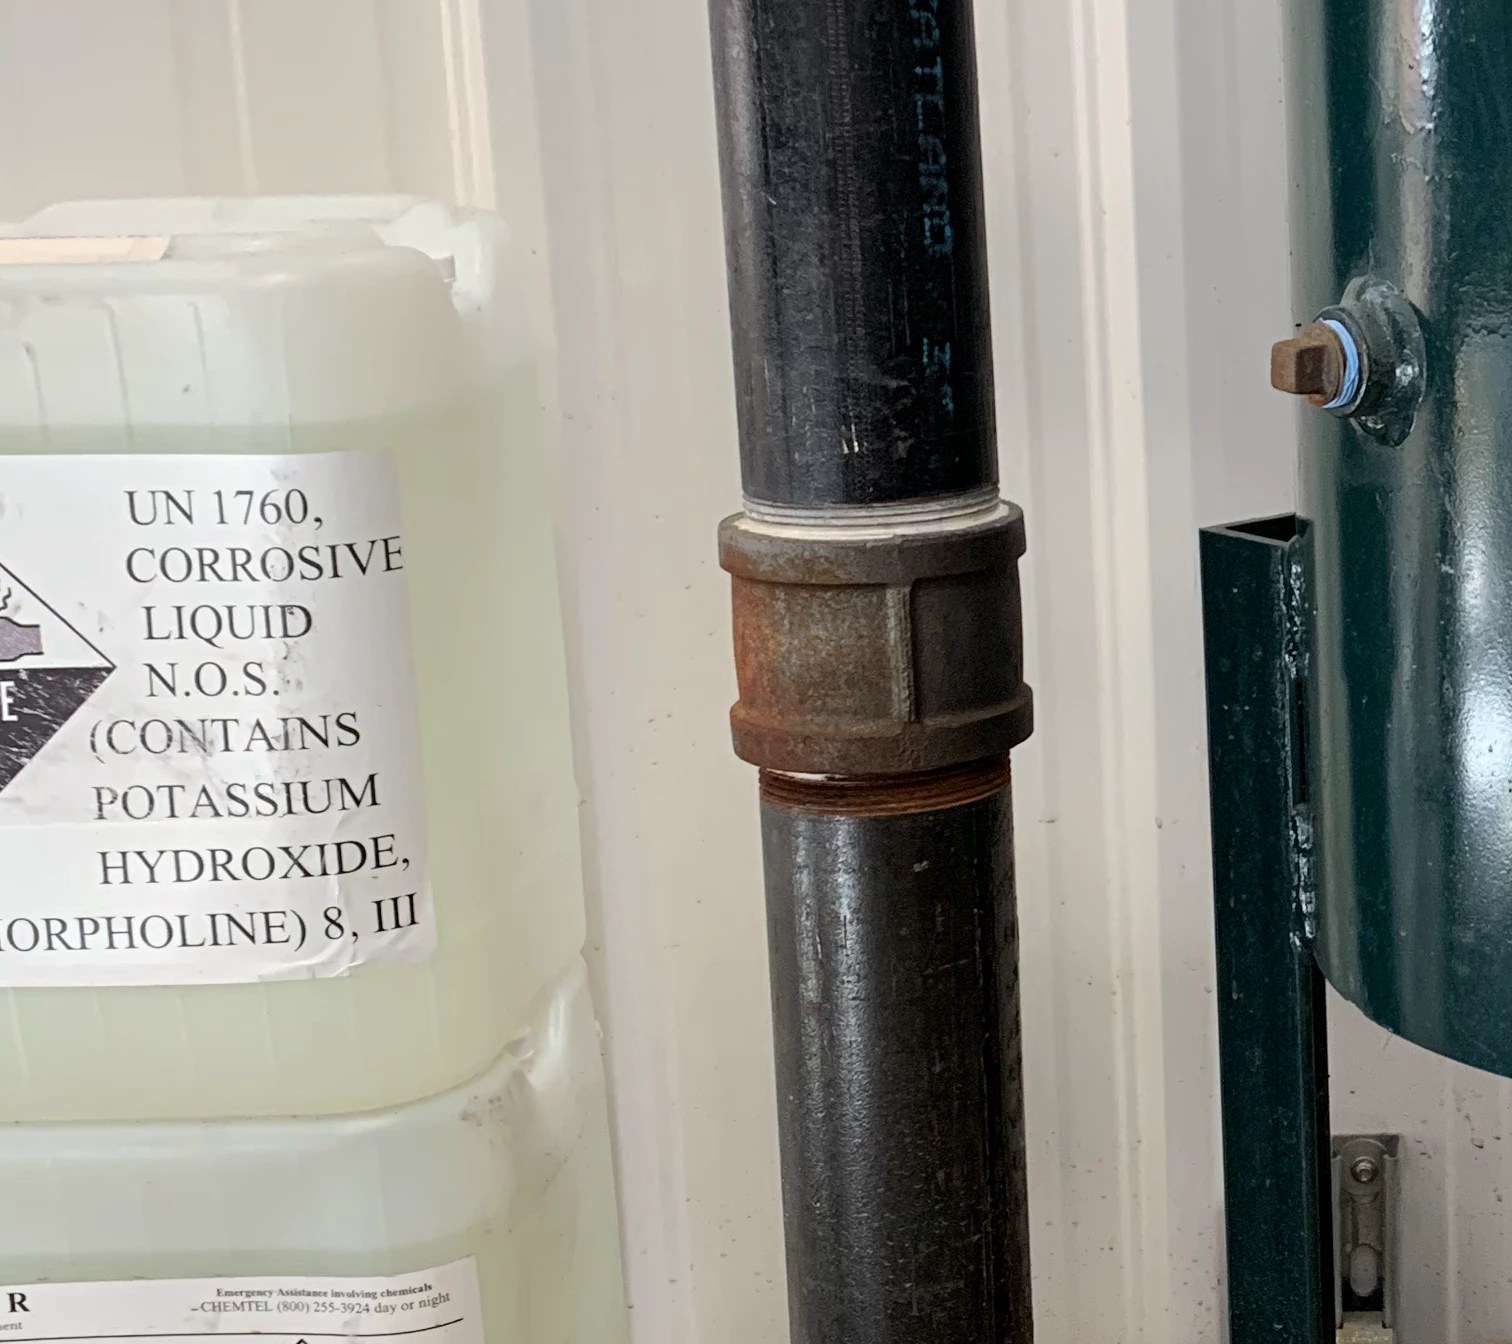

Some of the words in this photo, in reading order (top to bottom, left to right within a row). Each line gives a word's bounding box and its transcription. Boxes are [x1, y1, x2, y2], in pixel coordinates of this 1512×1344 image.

[124, 489, 195, 526] UN
[215, 488, 323, 531] 1760,
[126, 535, 403, 585] CORROSIVE
[142, 604, 313, 649] LIQUID
[146, 660, 280, 698] N.O.S.
[89, 712, 361, 764] (CONTAINS
[92, 773, 381, 821] POTASSIUM
[98, 834, 410, 885] HYDROXIDE,
[0, 910, 307, 953] ORPHOLINE)
[323, 906, 359, 945] 8,
[371, 893, 419, 933] III
[7, 1292, 30, 1313] R
[216, 1288, 274, 1300] Emergency
[277, 1287, 328, 1298] Assistance
[330, 1289, 378, 1300] involving
[380, 1282, 432, 1298] chemicals
[276, 1300, 310, 1314] (800)
[313, 1301, 370, 1314] 255-3924
[373, 1300, 396, 1316] day
[401, 1301, 415, 1312] or
[418, 1291, 451, 1309] night
